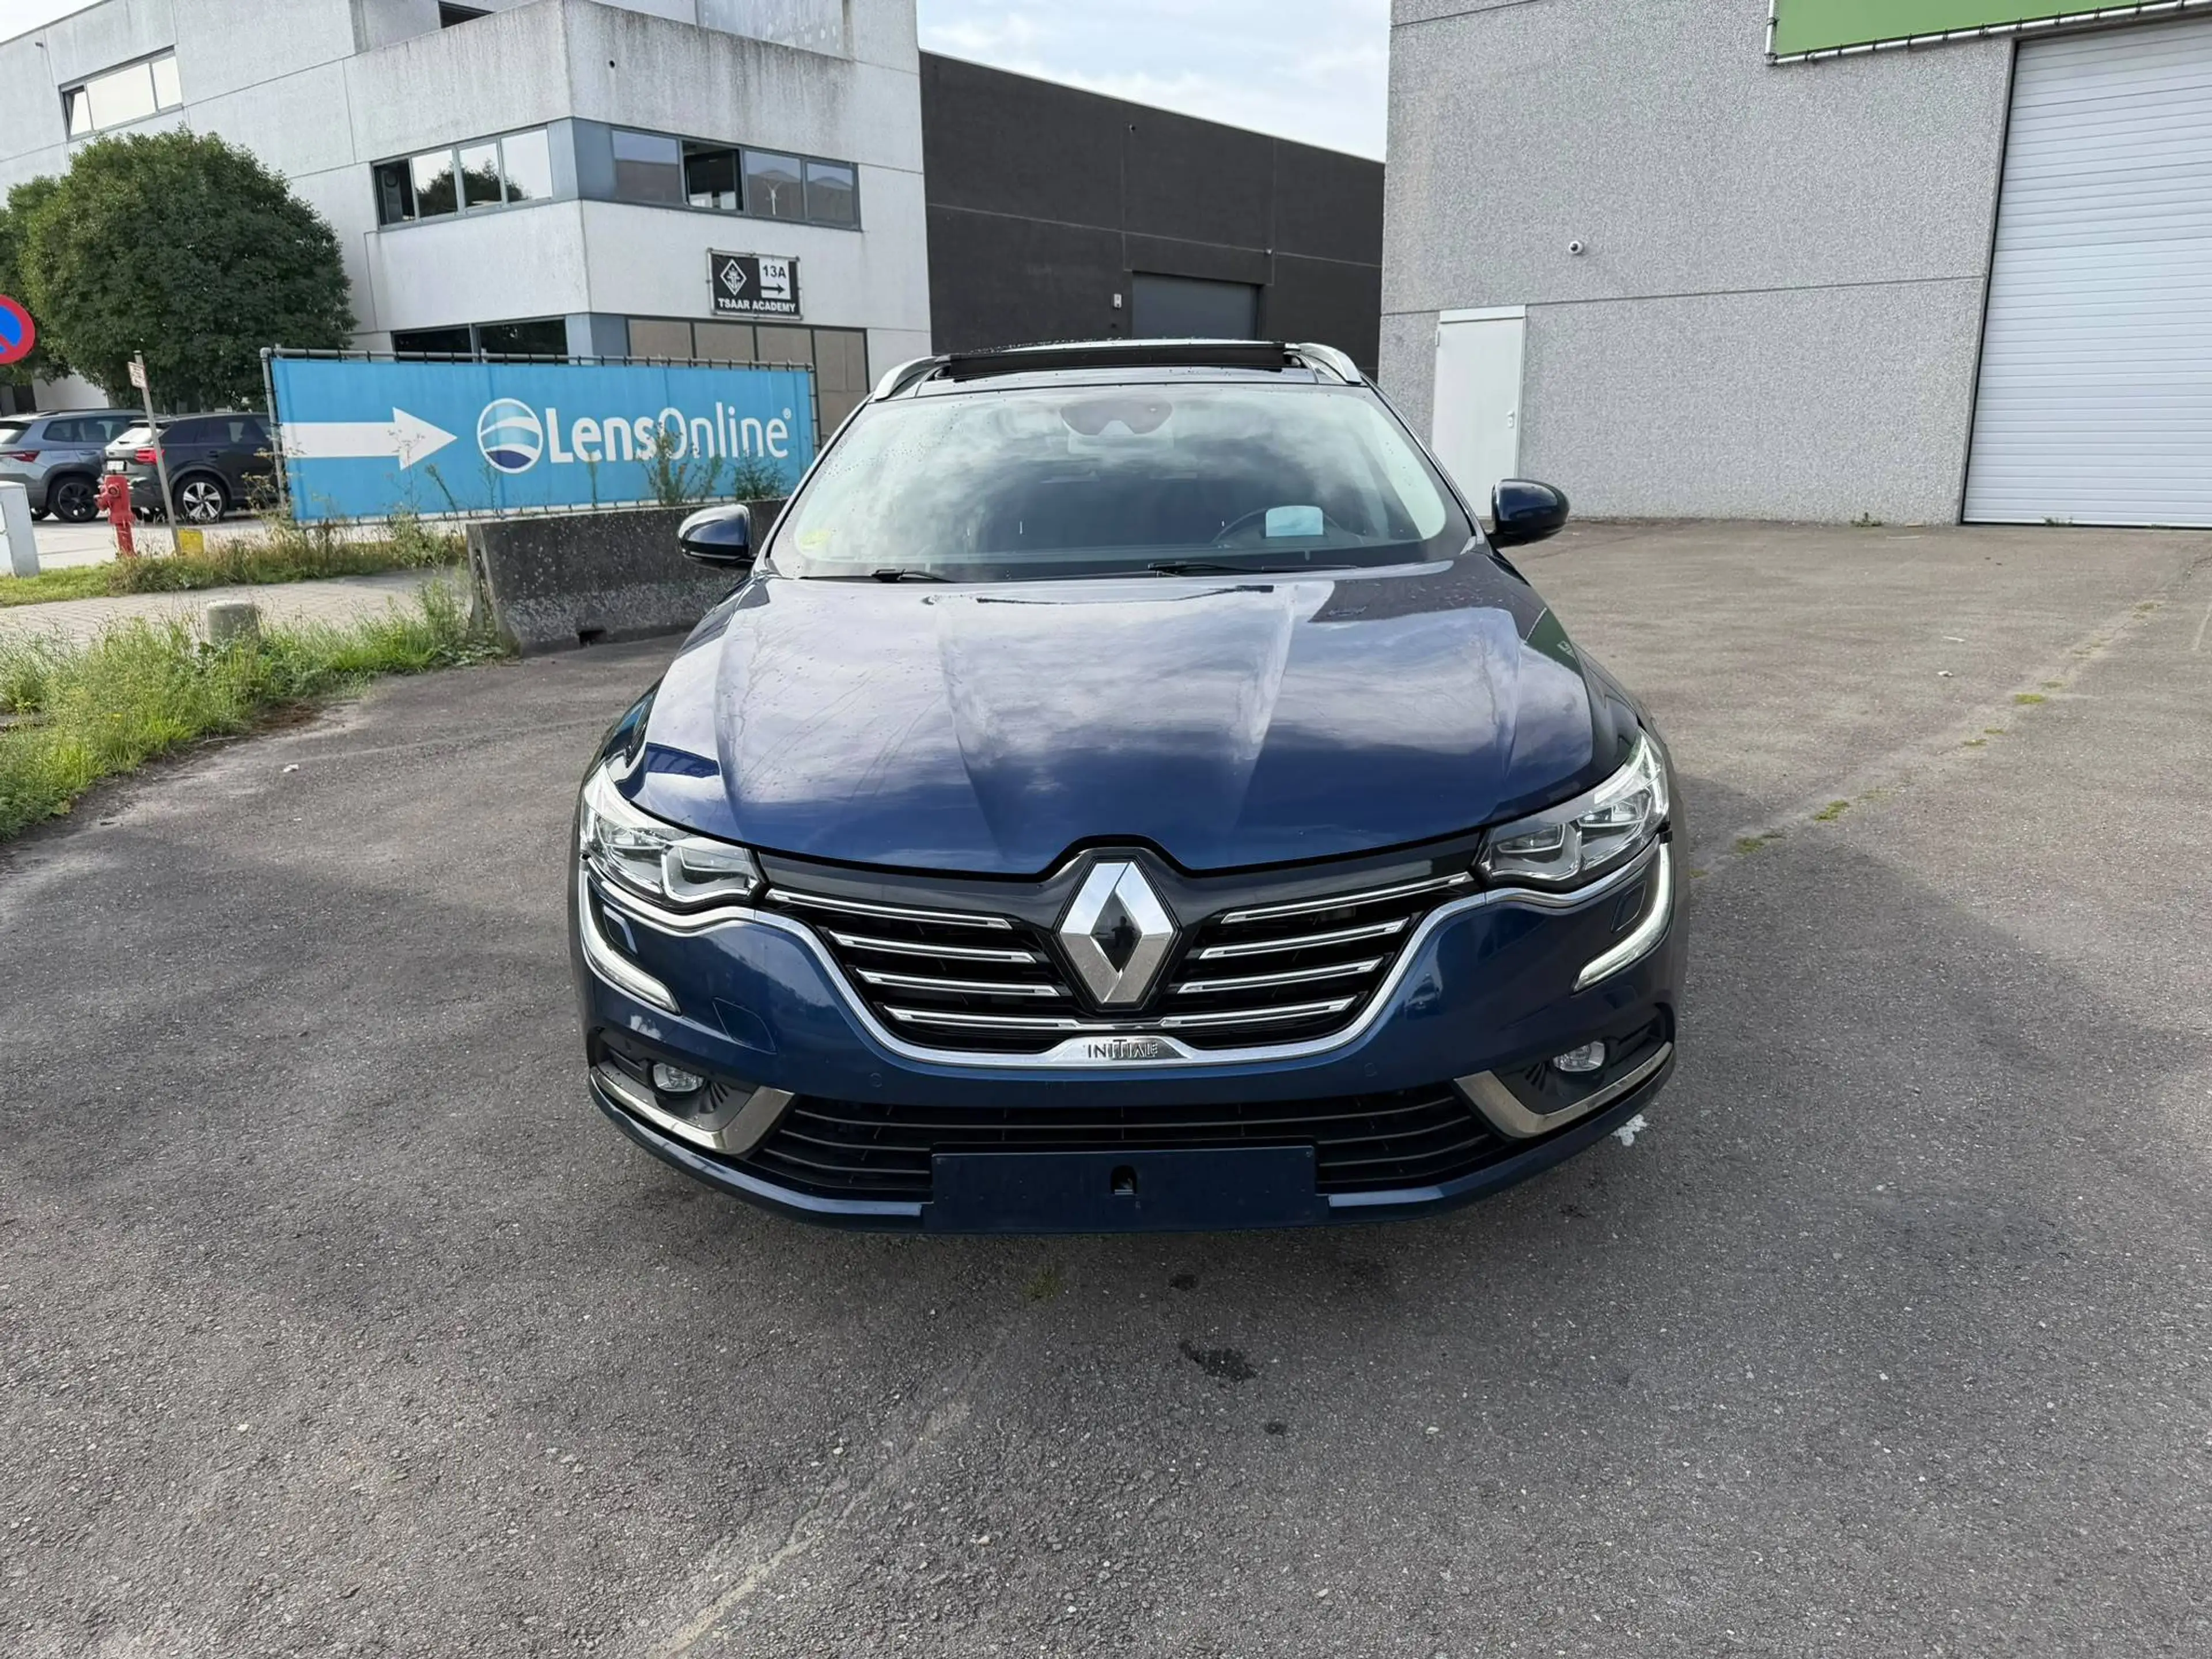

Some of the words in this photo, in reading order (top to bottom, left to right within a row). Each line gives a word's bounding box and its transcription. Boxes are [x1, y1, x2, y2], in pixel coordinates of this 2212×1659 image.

[762, 264, 787, 279] 13A
[718, 297, 750, 309] TSAAR
[751, 300, 796, 312] ACADEMY
